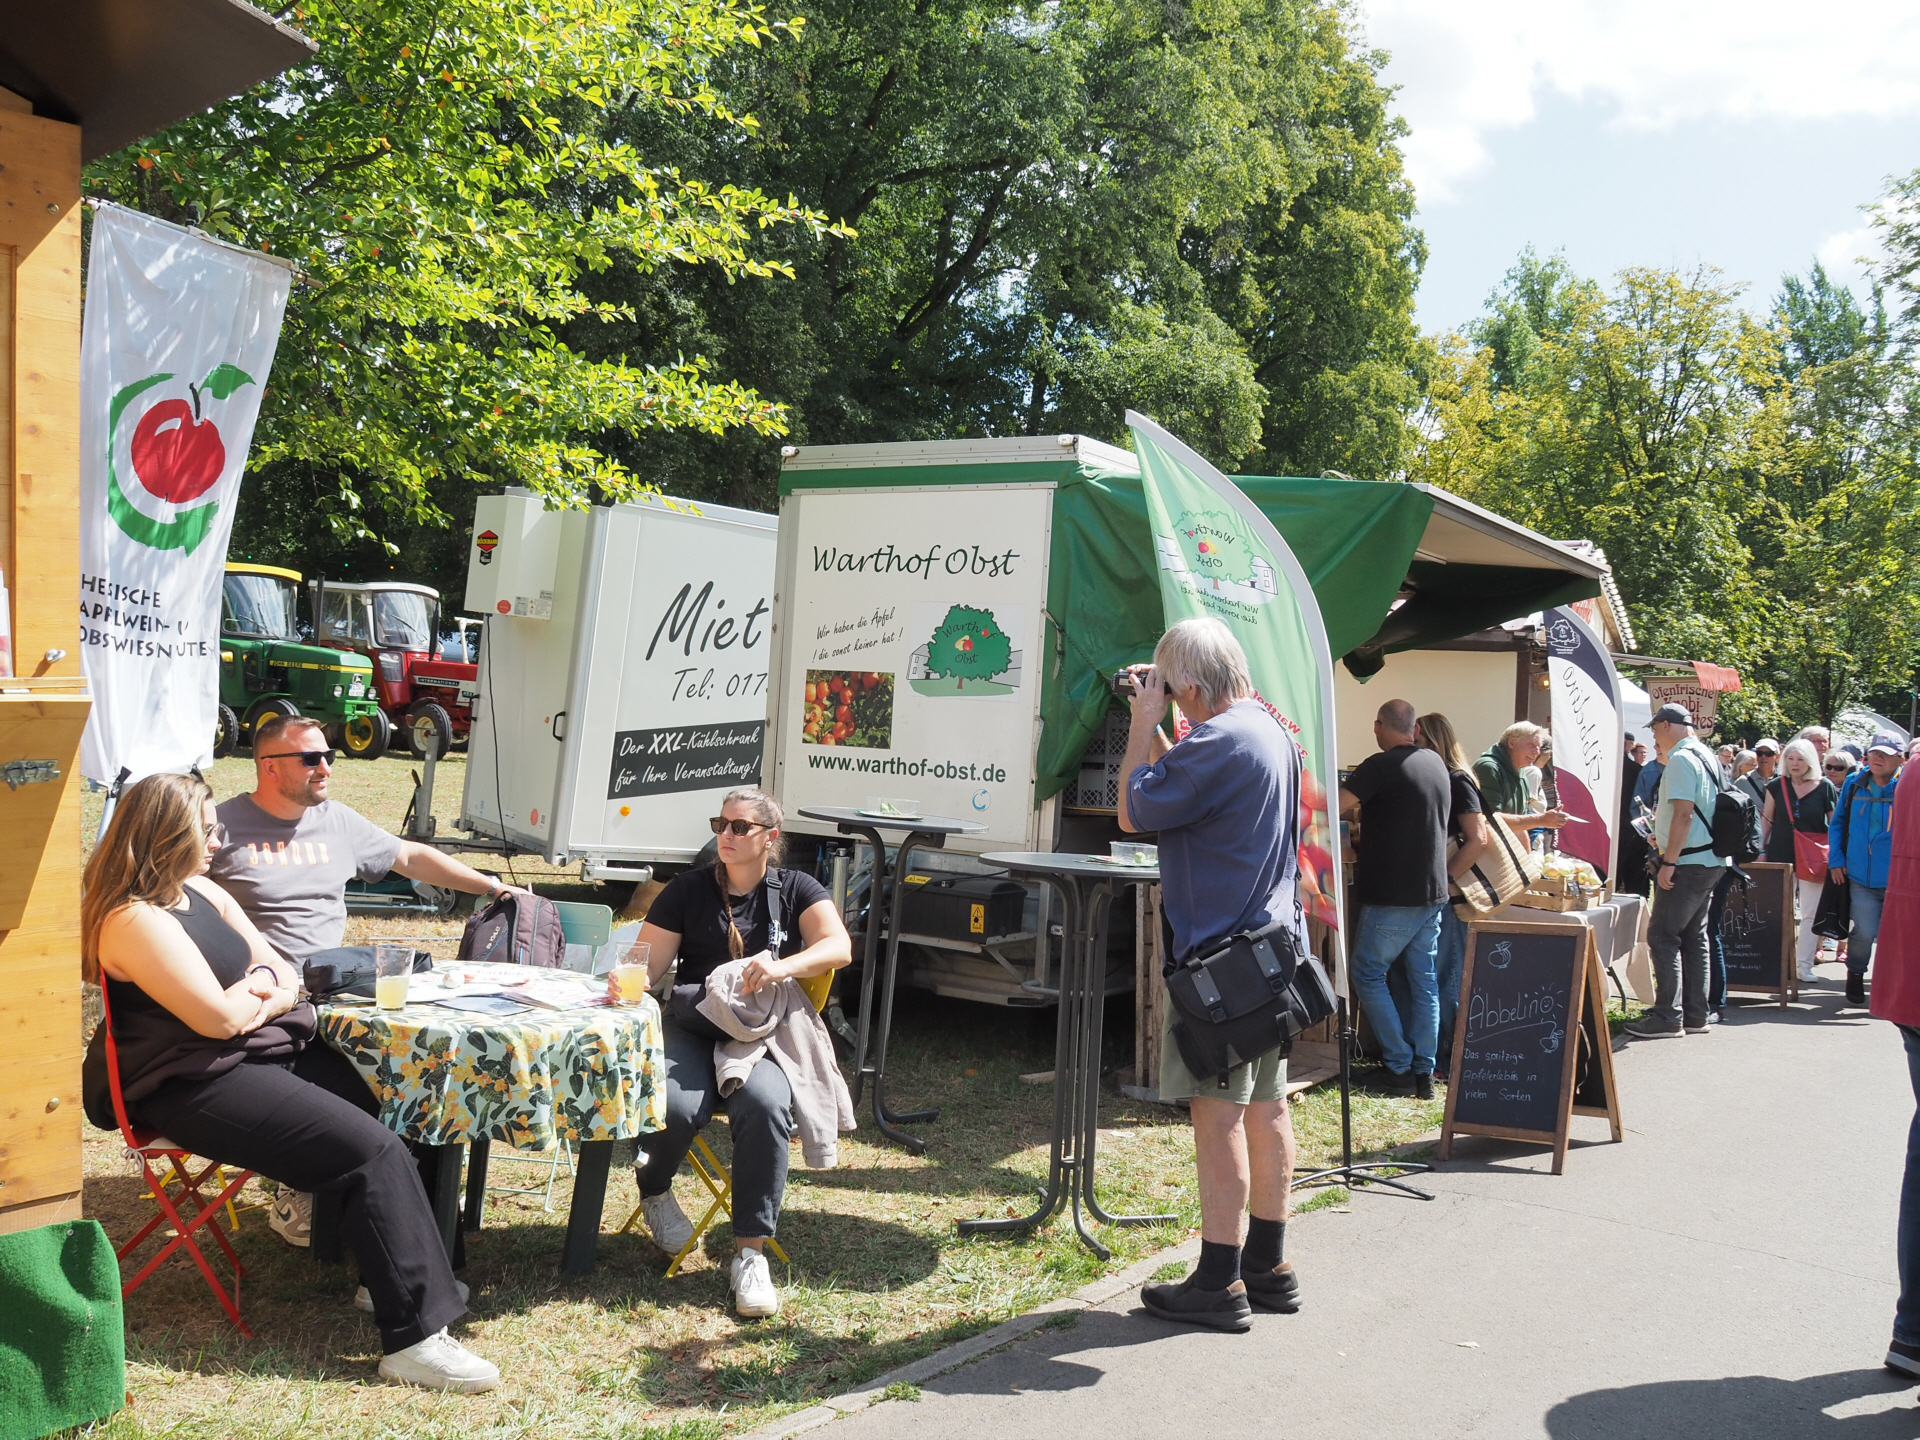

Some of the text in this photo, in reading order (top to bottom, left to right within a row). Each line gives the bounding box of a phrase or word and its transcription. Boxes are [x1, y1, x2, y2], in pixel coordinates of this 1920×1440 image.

[813, 545, 1021, 580] Warthof Obst
[645, 580, 769, 661] Miet
[816, 606, 896, 640] Wir haben die Äpfel
[818, 647, 829, 660] die
[831, 642, 851, 657] sonst
[853, 638, 878, 651] keiner
[881, 631, 895, 644] hat
[955, 653, 978, 664] Obst
[419, 678, 459, 686] INTERNATIONAL
[672, 668, 768, 701] Tel: 017
[619, 726, 760, 757] Der XXL-Kühlschrank
[615, 755, 760, 793] für Ihre Veranstaltung!
[808, 753, 1007, 783] www.warthof-obst.de
[1464, 1048, 1525, 1065] Das spritzige
[1527, 1072, 1537, 1081] in
[1498, 1087, 1531, 1101] Sorten
